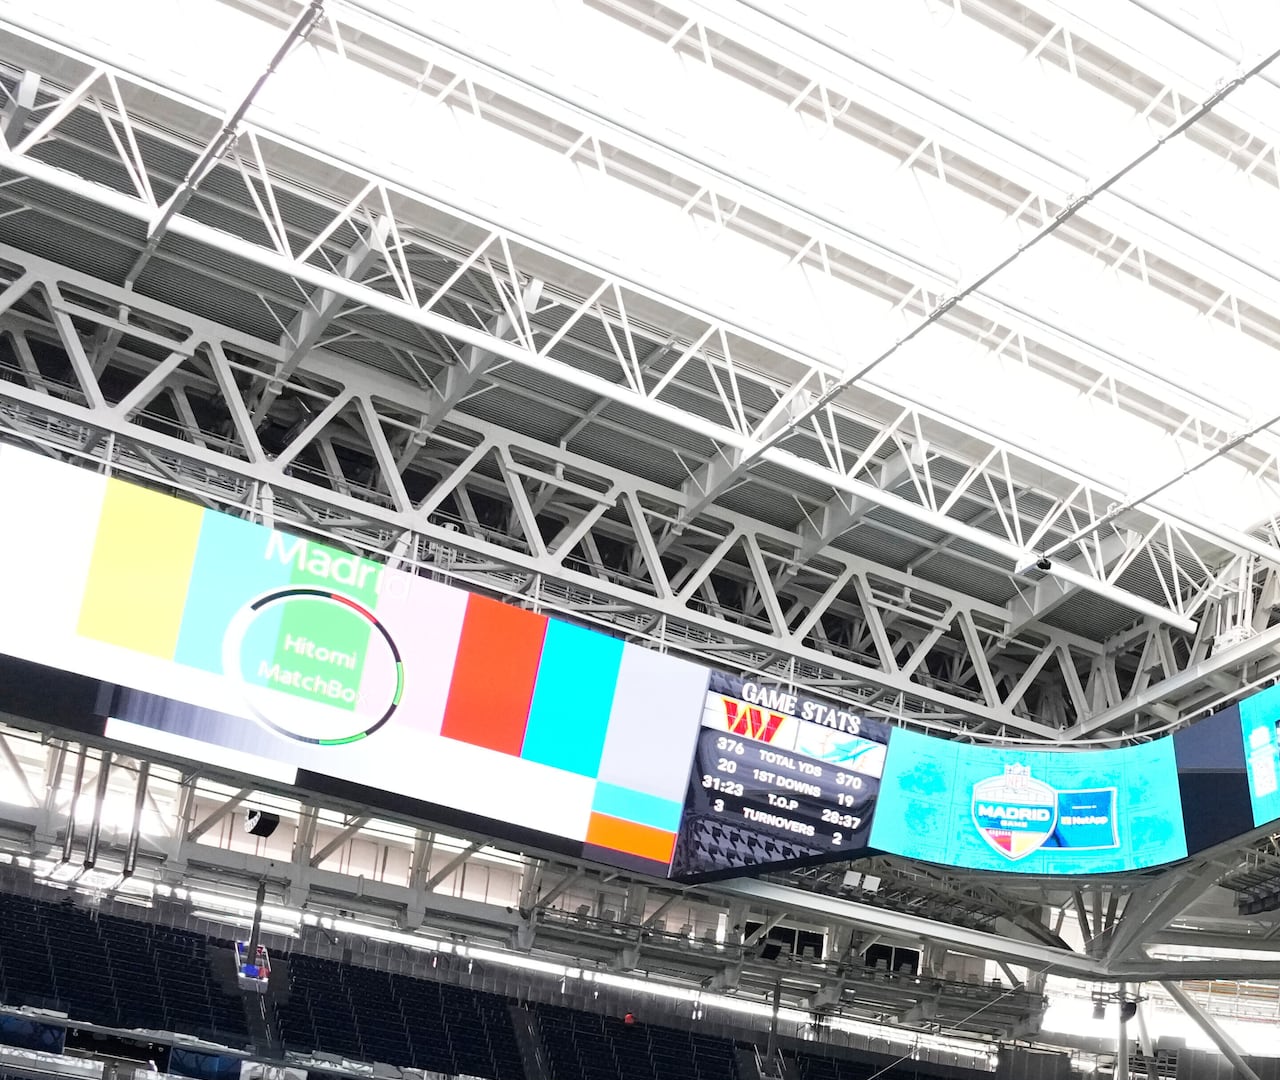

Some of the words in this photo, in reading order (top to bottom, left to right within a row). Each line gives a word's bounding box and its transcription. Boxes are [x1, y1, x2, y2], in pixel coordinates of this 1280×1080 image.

[284, 633, 358, 671] Hitomi
[742, 683, 797, 715] GAME
[801, 702, 861, 735] STATS
[717, 737, 745, 755] 376
[759, 749, 796, 770] TOTAL
[798, 760, 823, 777] YDS
[836, 772, 862, 789] 370
[717, 758, 737, 774] 20
[753, 768, 775, 784] 1ST
[775, 775, 821, 797] DOWNS
[837, 793, 855, 808] 19
[702, 774, 744, 797] 31:23
[767, 794, 799, 810] T.O.P
[821, 809, 862, 829] 28:37
[713, 799, 724, 812] 3
[742, 807, 815, 836] TURNOVERS
[832, 833, 843, 845] 2
[978, 804, 1050, 822] MADRID
